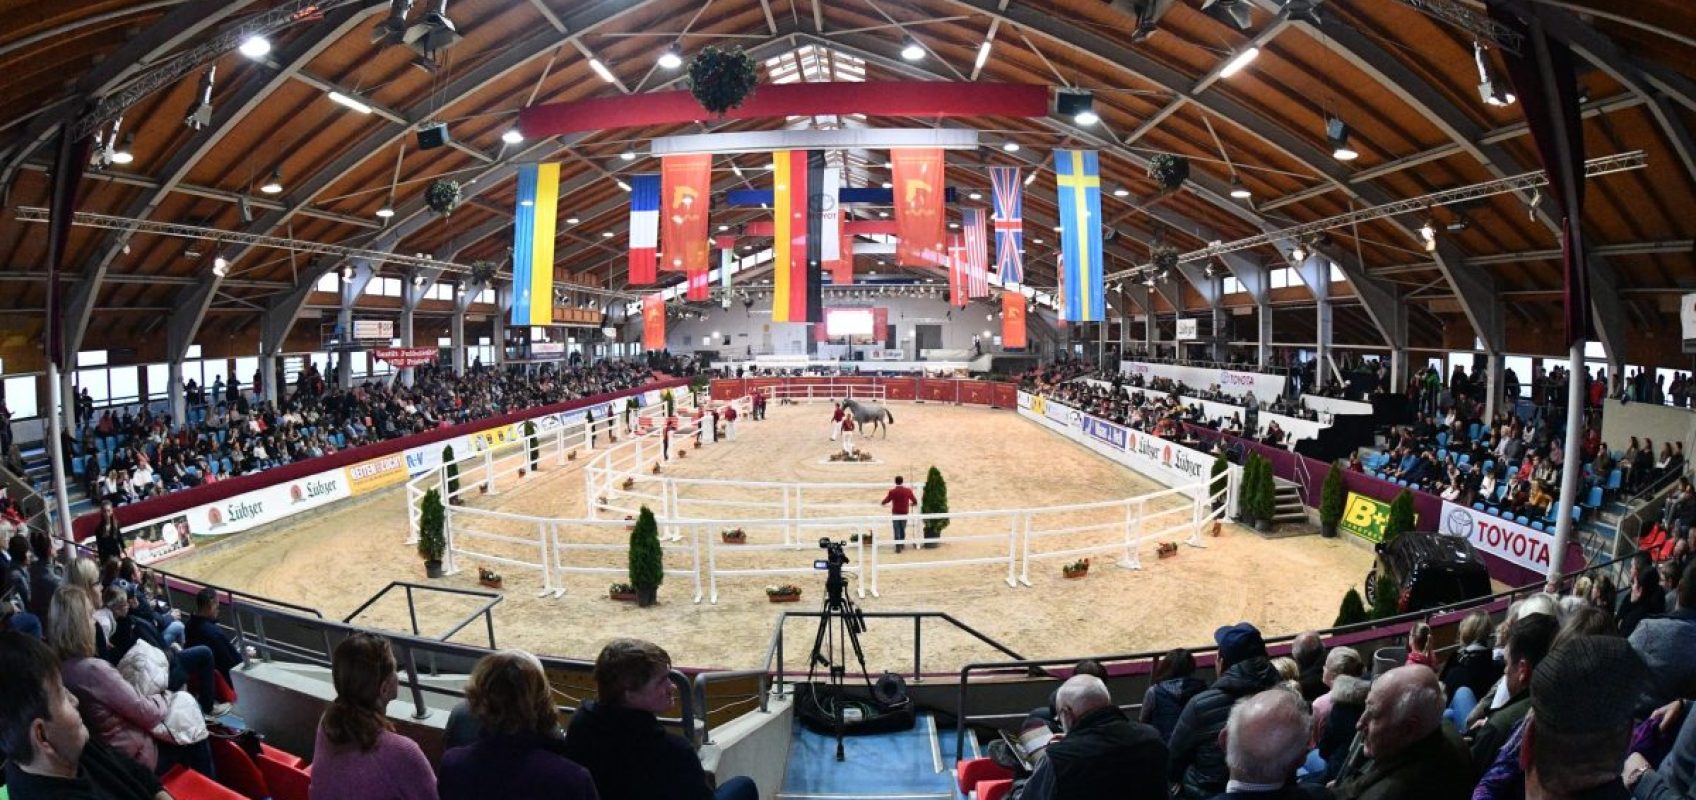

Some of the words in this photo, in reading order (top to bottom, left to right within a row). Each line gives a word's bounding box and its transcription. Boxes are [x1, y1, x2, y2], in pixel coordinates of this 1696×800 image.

[1230, 374, 1254, 387] TOYOTA
[1139, 435, 1160, 459] Lübzer
[1175, 450, 1202, 477] Lübzer
[306, 478, 338, 498] Lübzer
[228, 501, 264, 522] Lübzer
[1477, 520, 1550, 568] TOYOTA
